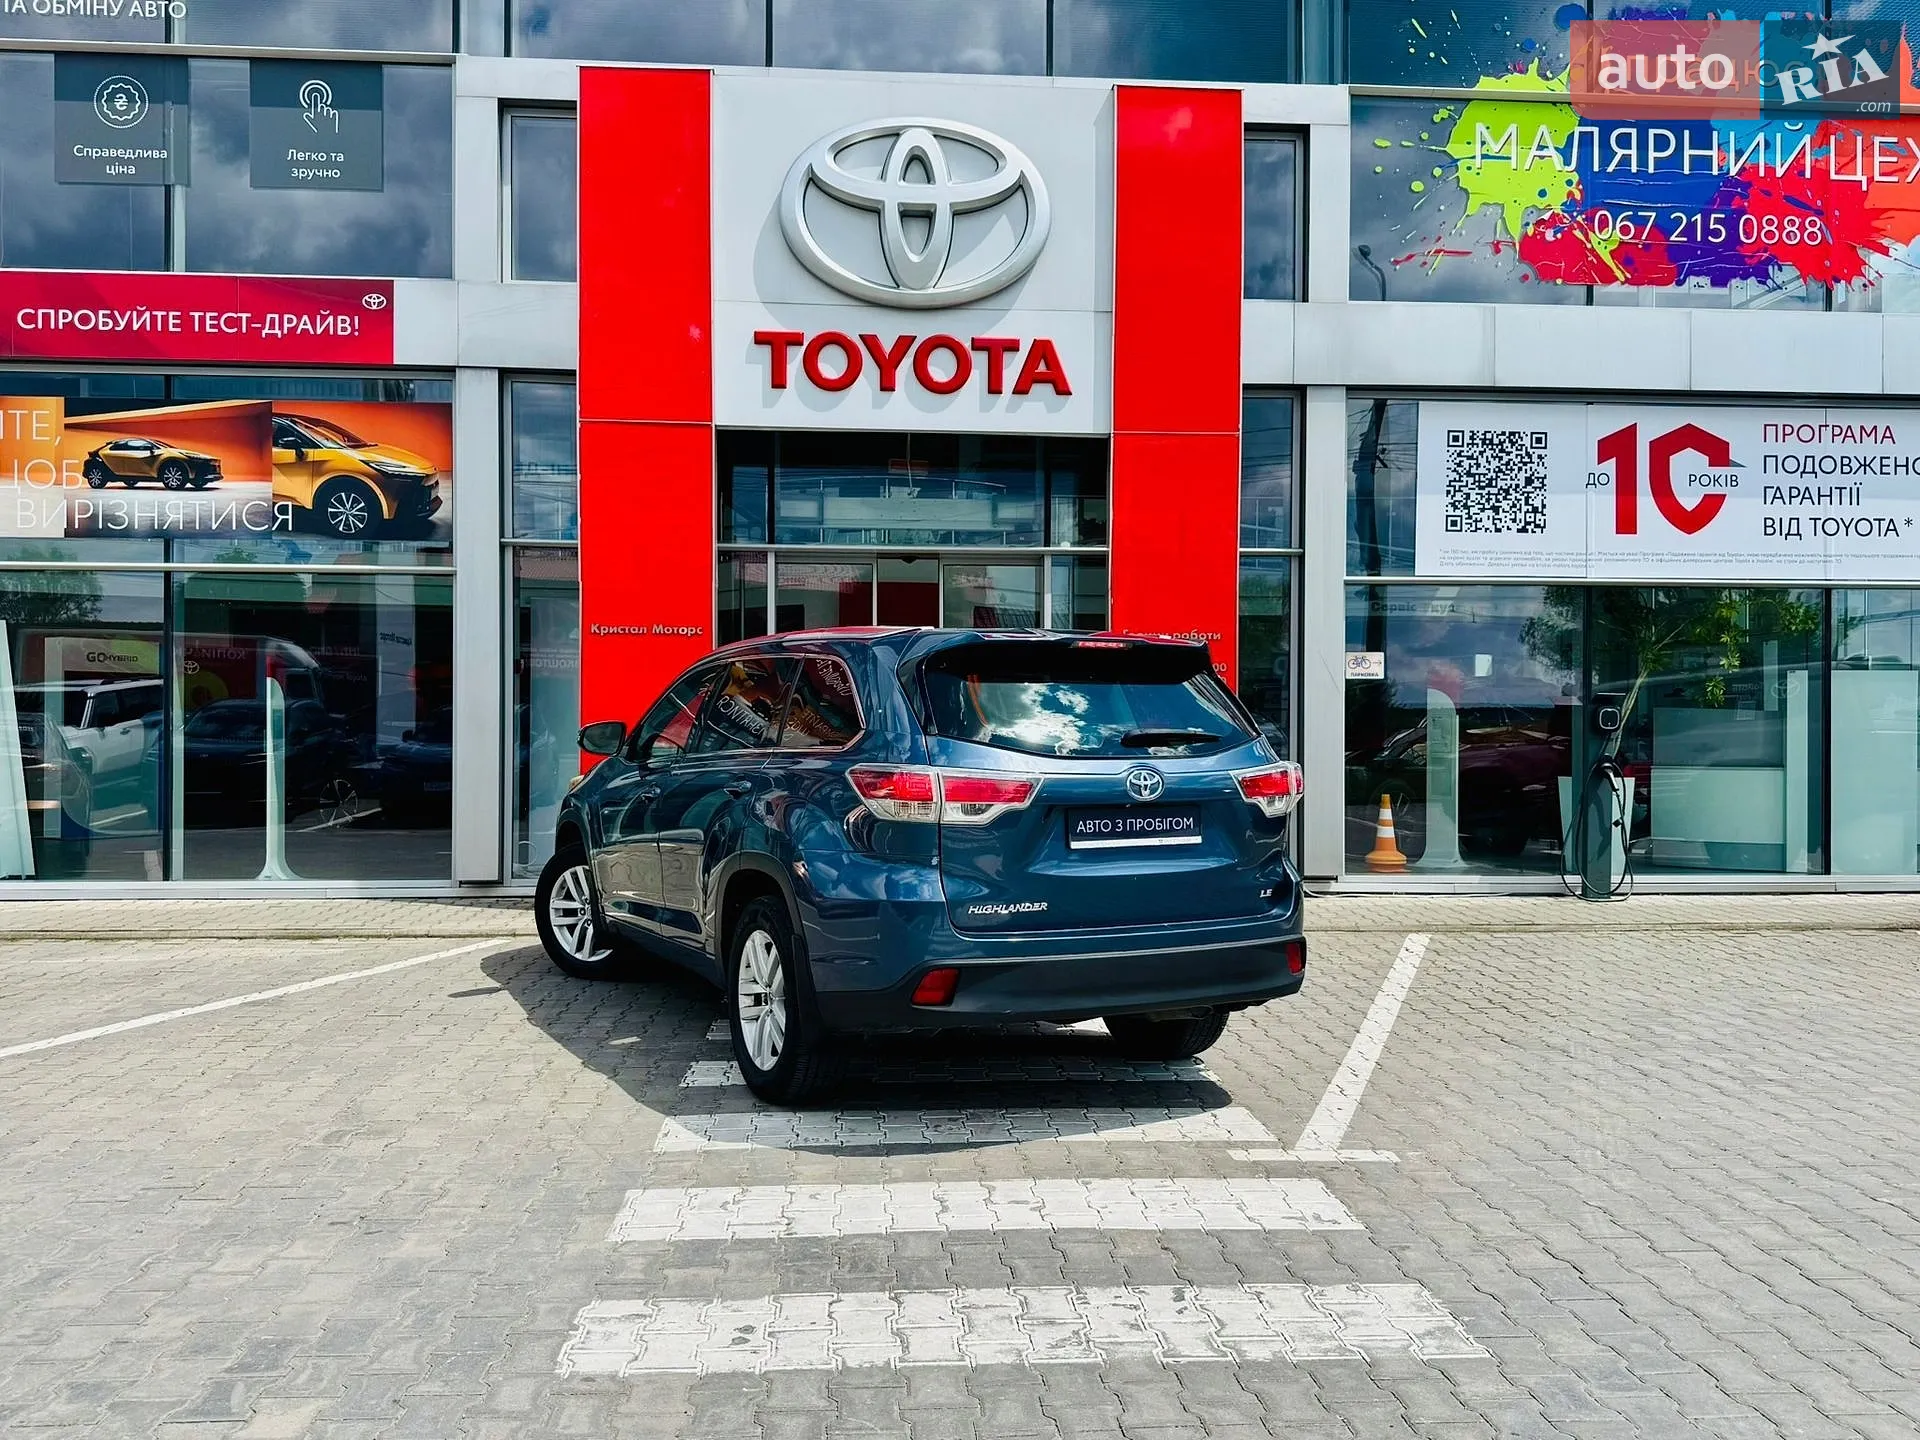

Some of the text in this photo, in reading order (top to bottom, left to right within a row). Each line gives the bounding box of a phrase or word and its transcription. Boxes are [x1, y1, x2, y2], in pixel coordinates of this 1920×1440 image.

[33, 0, 125, 17] ОБМІНУ
[128, 1, 187, 18] АВТО
[73, 144, 168, 160] Справедлива
[287, 150, 344, 162] Легко та
[1474, 121, 1811, 180] МАЛЯРНИЙ
[106, 163, 136, 176] ціна
[291, 167, 341, 180] зручно
[1594, 210, 1822, 246] 067 215 0888
[16, 306, 360, 338] СПРОБУЙТЕ ТЕСТ-ДРАЙВ!
[753, 330, 1073, 396] TOYOTA
[0, 409, 62, 447] ТЕ,
[1762, 423, 1896, 445] ПРОГРАМА
[1585, 472, 1610, 489] ДО
[1688, 473, 1739, 488] РОКІВ
[1762, 481, 1863, 506] ГАРАНТІЇ
[16, 498, 294, 531] ВИРІЗНЯТИСЯ
[1763, 516, 1802, 541] ВІД
[590, 623, 704, 636] Кристал Моторс
[1076, 816, 1194, 833] АВТО З ПРОБІГОМ
[1260, 888, 1273, 898] LE
[967, 901, 1048, 914] HIGHLANDER
